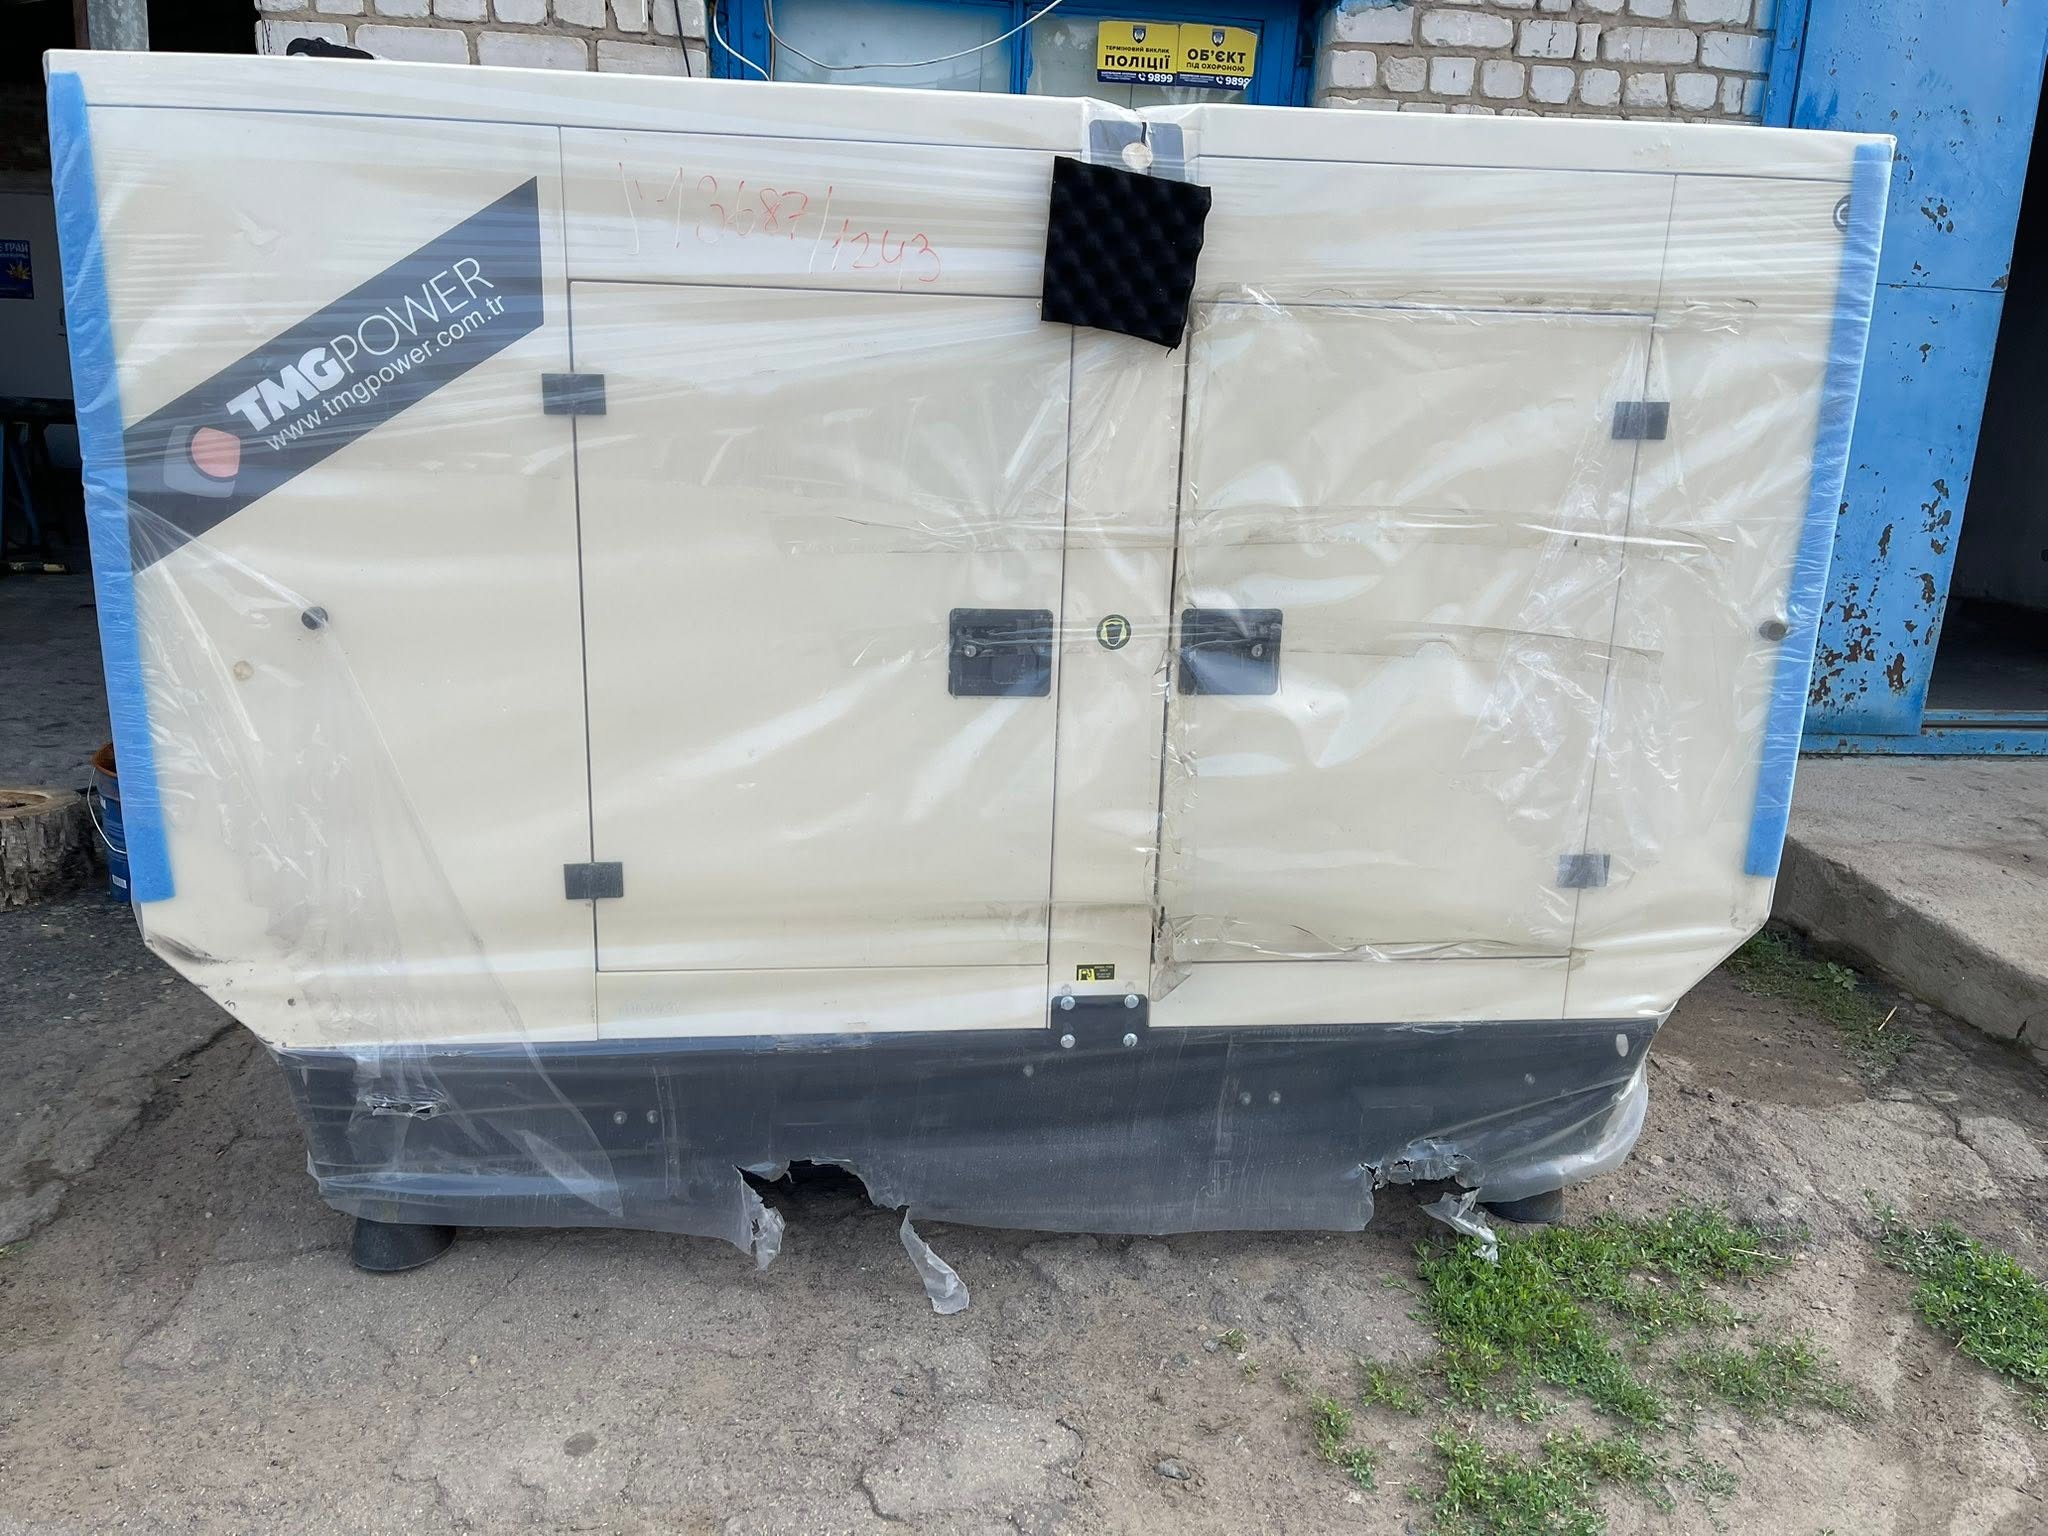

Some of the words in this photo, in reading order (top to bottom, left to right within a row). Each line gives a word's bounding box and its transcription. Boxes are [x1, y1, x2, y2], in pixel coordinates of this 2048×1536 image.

[1105, 54, 1171, 70] ПОЛІЦІЇ
[1201, 63, 1245, 72] ОХОРОНОЮ
[1147, 73, 1174, 83] 9899
[265, 293, 506, 452] www.tmgpower.com.tr
